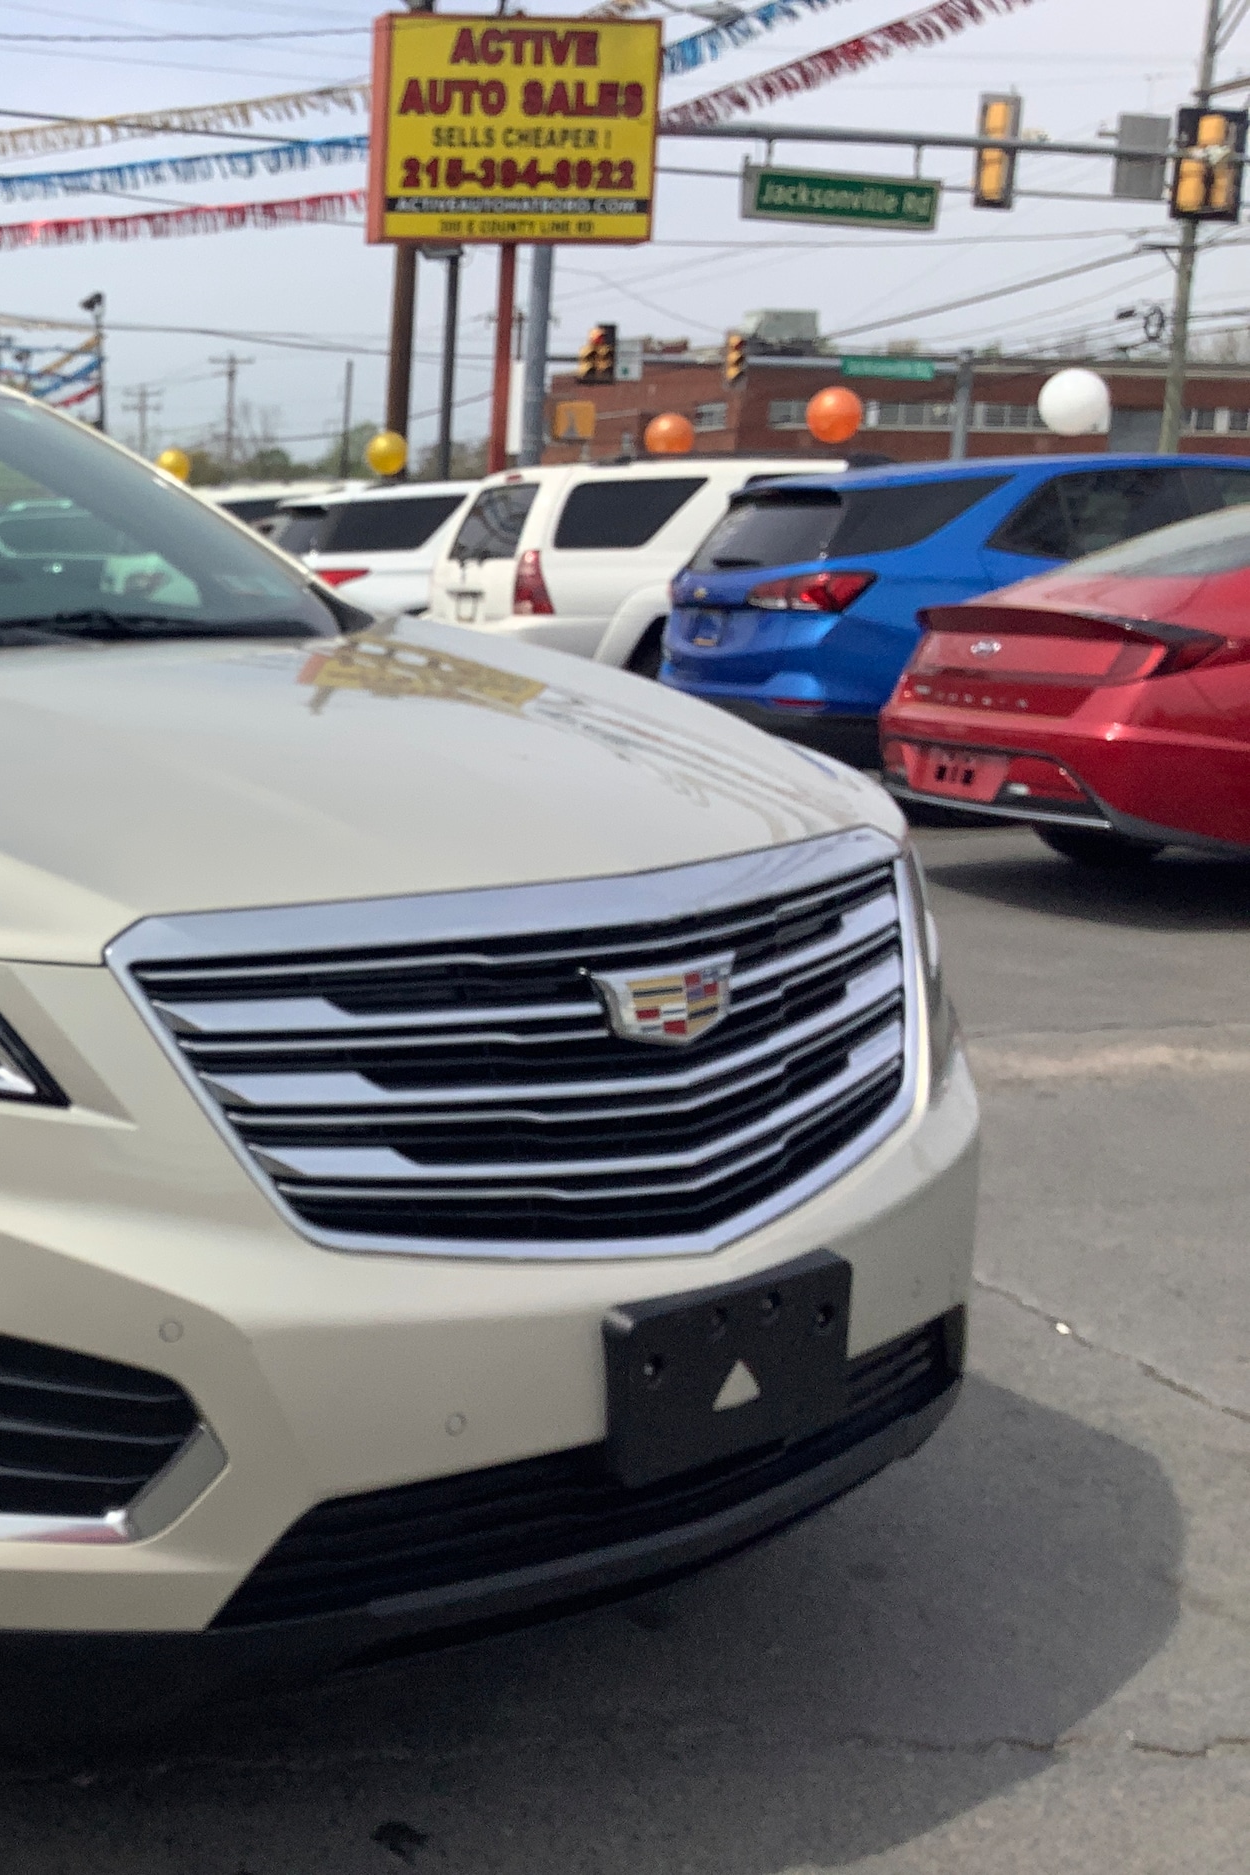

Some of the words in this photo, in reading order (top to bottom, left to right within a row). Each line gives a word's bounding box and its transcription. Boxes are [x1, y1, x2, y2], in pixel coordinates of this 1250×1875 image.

[450, 27, 599, 67] ACTIVE
[398, 78, 506, 116] AUTO
[521, 80, 644, 118] SALES
[431, 126, 495, 149] SELLS
[502, 127, 598, 149] CHEAPER
[762, 181, 899, 214] Jacksonville
[902, 191, 931, 217] Rd
